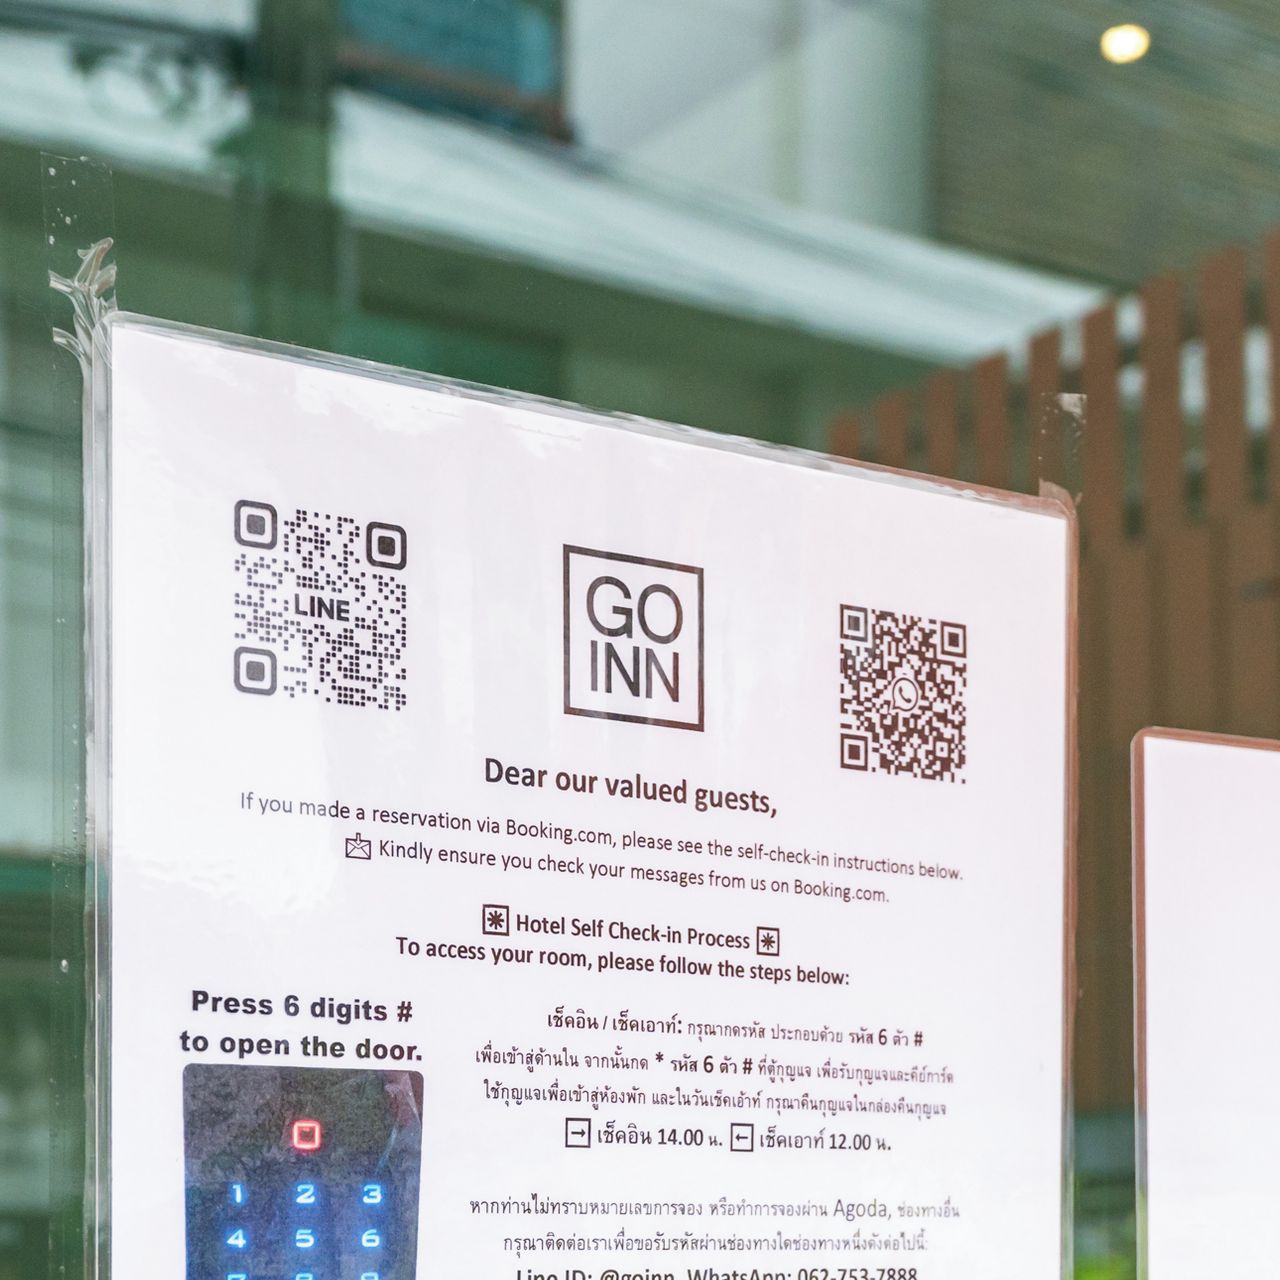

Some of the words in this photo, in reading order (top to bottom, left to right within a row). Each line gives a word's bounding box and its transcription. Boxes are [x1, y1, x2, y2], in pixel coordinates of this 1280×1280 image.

[295, 594, 350, 622] LINE
[586, 576, 683, 645] GO
[591, 640, 679, 703] INN
[485, 758, 548, 788] Dear
[555, 772, 598, 793] our
[605, 773, 687, 804] valued
[695, 788, 777, 818] guests,
[242, 791, 254, 809] If
[259, 798, 292, 815] you
[300, 800, 350, 819] made
[356, 808, 365, 820] a
[373, 809, 471, 831] reservation
[477, 816, 500, 834] via
[507, 819, 616, 848] Booking.com,
[623, 830, 672, 851] please
[677, 840, 702, 854] see
[707, 839, 732, 857] the
[737, 843, 829, 866] self-check-in
[834, 853, 914, 875] instructions
[919, 862, 962, 880] below.
[380, 840, 433, 864] Kindly
[438, 849, 496, 866] ensure
[501, 855, 532, 871] you
[538, 854, 584, 874] check
[589, 863, 625, 879] your
[631, 867, 704, 888] messages
[708, 870, 745, 888] from
[751, 879, 766, 891] us
[771, 881, 789, 893] on
[794, 879, 888, 903] Booking.com.
[517, 914, 565, 934] Hotel
[571, 918, 604, 937] Self
[609, 921, 681, 943] Check-in
[688, 928, 750, 949] Process
[396, 936, 420, 956] To
[426, 943, 485, 960] access
[491, 947, 534, 965] your
[539, 951, 592, 971] room,
[598, 951, 654, 972] please
[659, 955, 712, 975] follow
[717, 960, 745, 978] the
[750, 964, 791, 984] steps
[797, 965, 849, 985] below:
[192, 990, 273, 1015] Press
[284, 995, 300, 1017] 6
[310, 997, 387, 1025] digits
[397, 1001, 412, 1022] #
[179, 1030, 209, 1052] to
[220, 1037, 290, 1059] open
[300, 1036, 345, 1058] the
[355, 1038, 422, 1061] door.
[603, 1016, 608, 1030] /
[878, 1028, 887, 1046] 6
[914, 1031, 923, 1046] #
[658, 1128, 704, 1146] 14.00
[708, 1136, 723, 1146] น.
[829, 1133, 871, 1151] 12.00
[876, 1138, 891, 1151] น.
[833, 1199, 891, 1222] Agoda,
